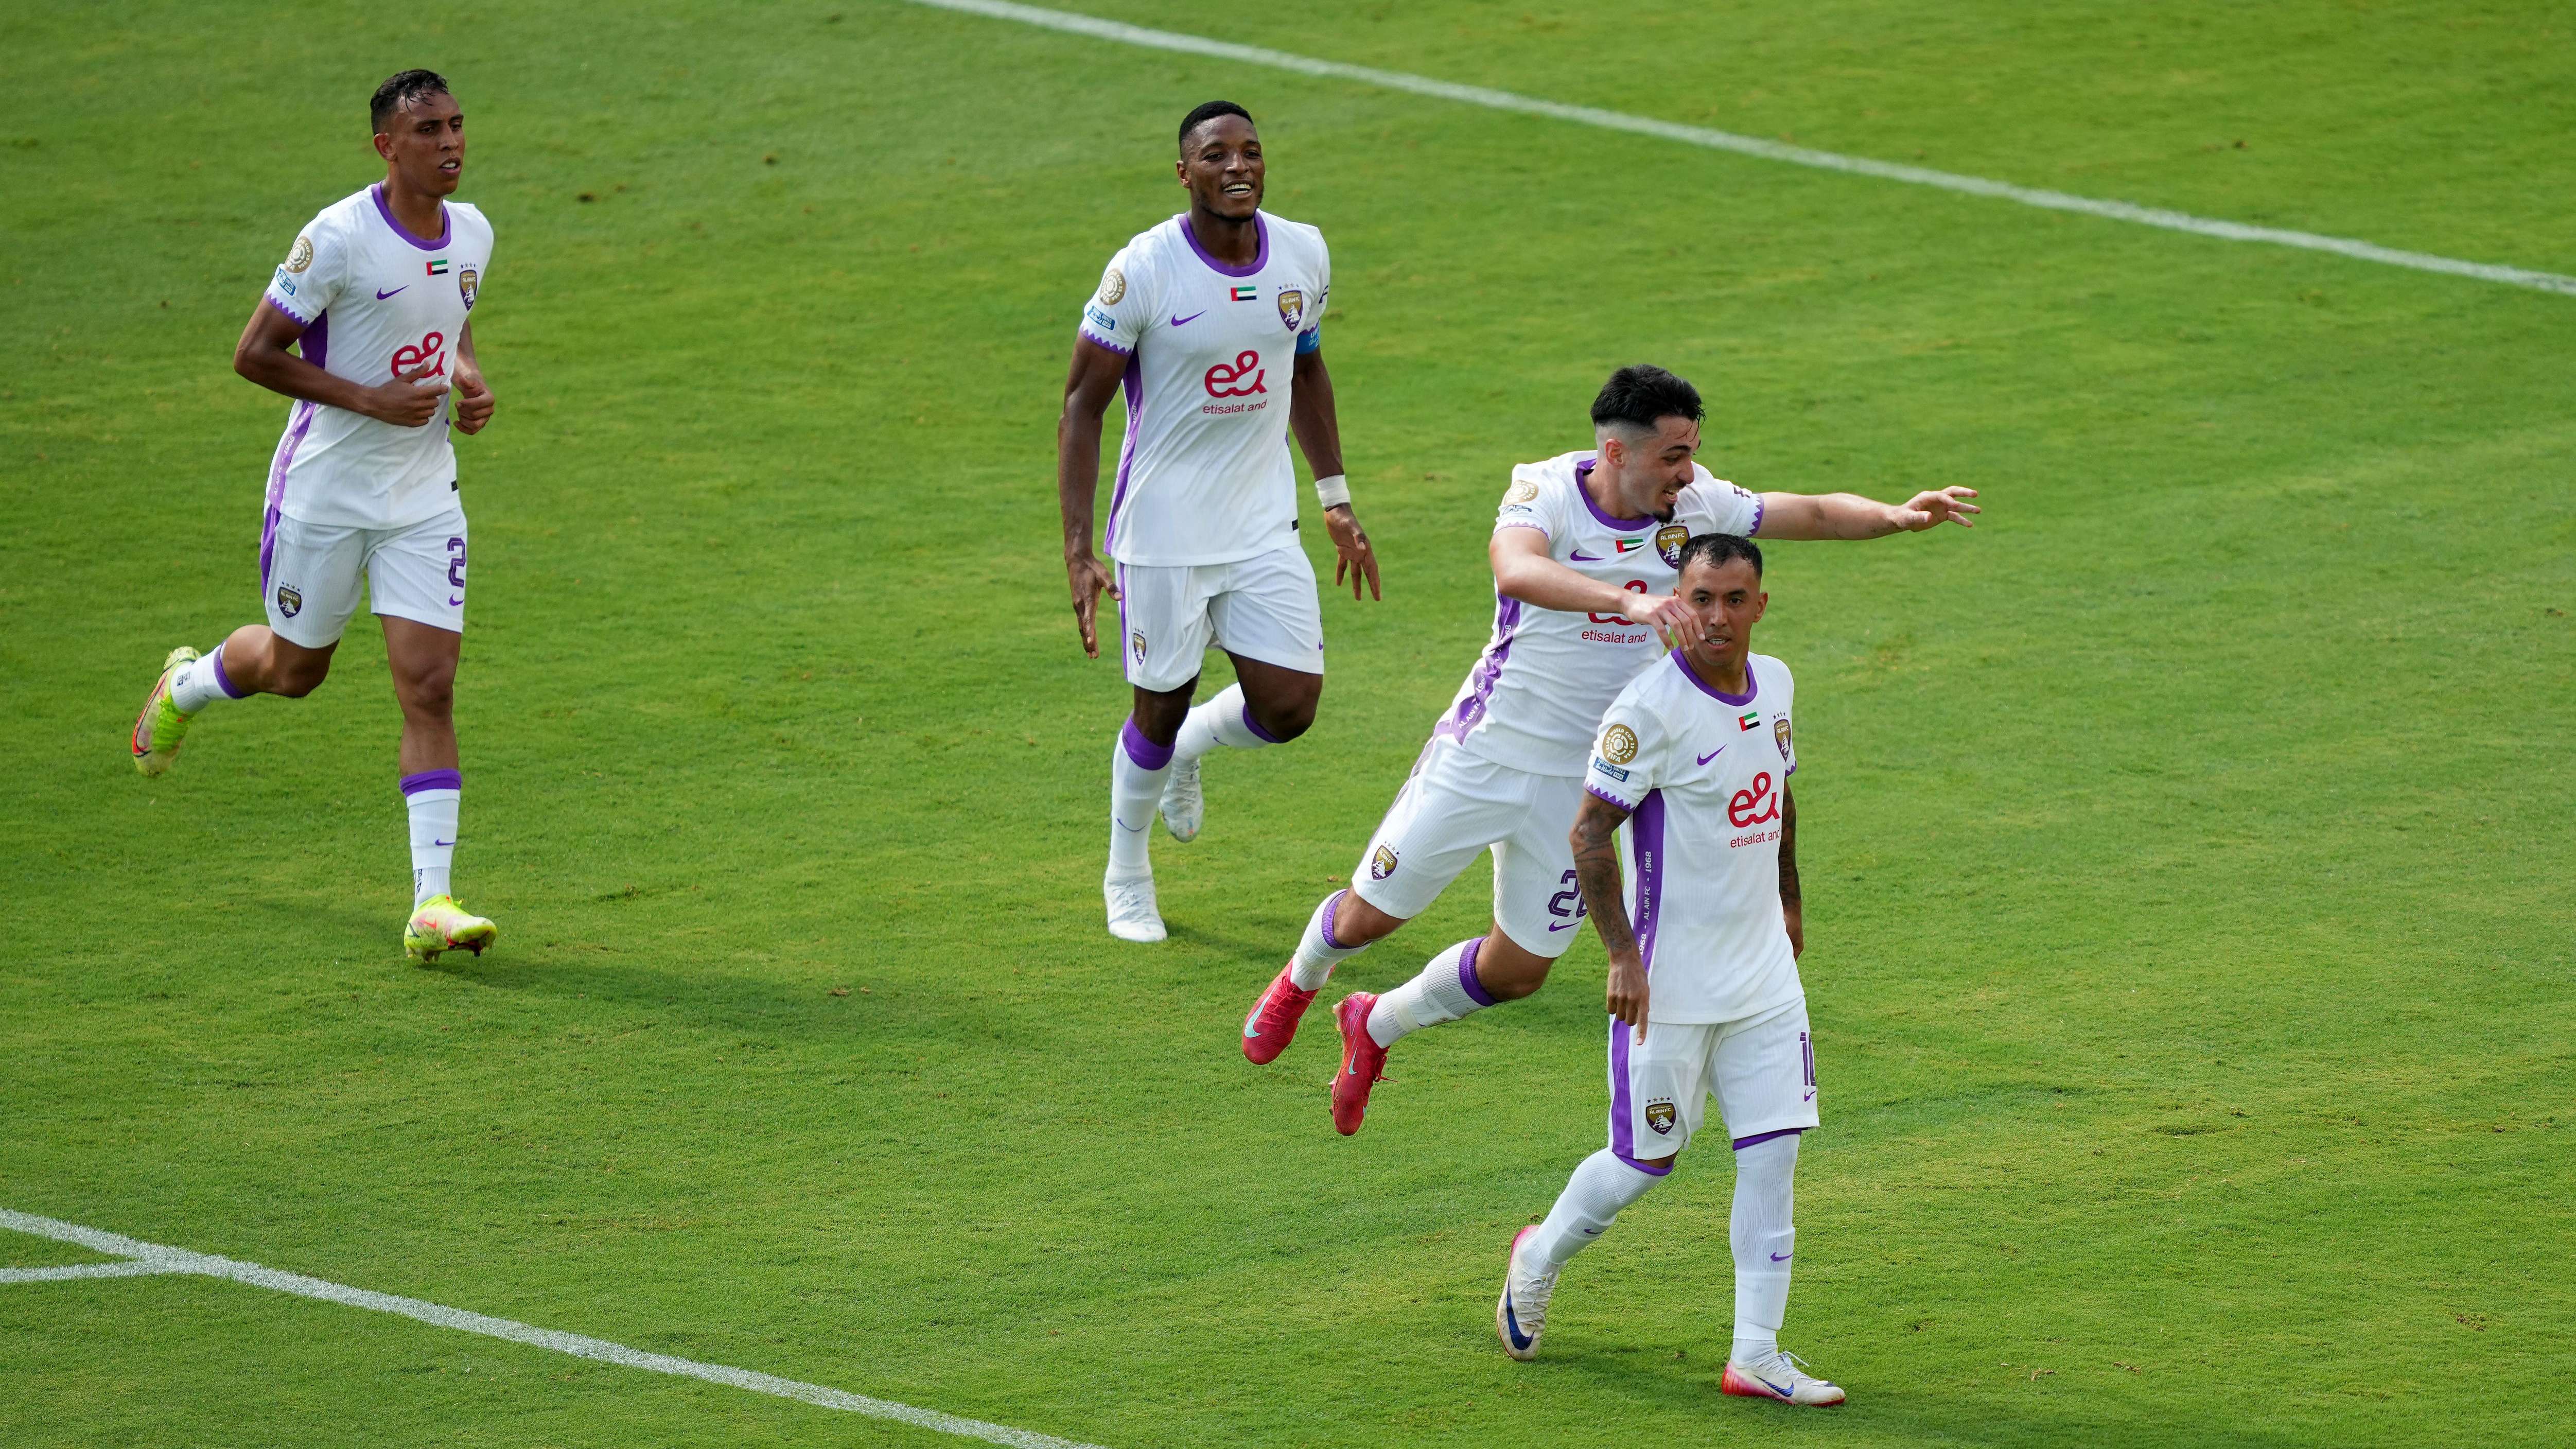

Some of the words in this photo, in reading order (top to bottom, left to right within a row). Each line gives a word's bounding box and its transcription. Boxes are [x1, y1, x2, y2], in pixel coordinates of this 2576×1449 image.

[1203, 404, 1245, 414] etisalat
[1248, 398, 1267, 412] and
[284, 435, 295, 455] 1968
[447, 537, 466, 588] 2
[1582, 630, 1625, 643] etisalat
[1627, 632, 1647, 643] and
[1466, 709, 1476, 722] AIN
[1607, 753, 1621, 762] FIFA
[1623, 749, 1633, 758] USA
[1730, 832, 1765, 848] etisalat
[1768, 826, 1780, 841] and
[1645, 885, 1651, 895] FC
[1643, 909, 1649, 920] AL
